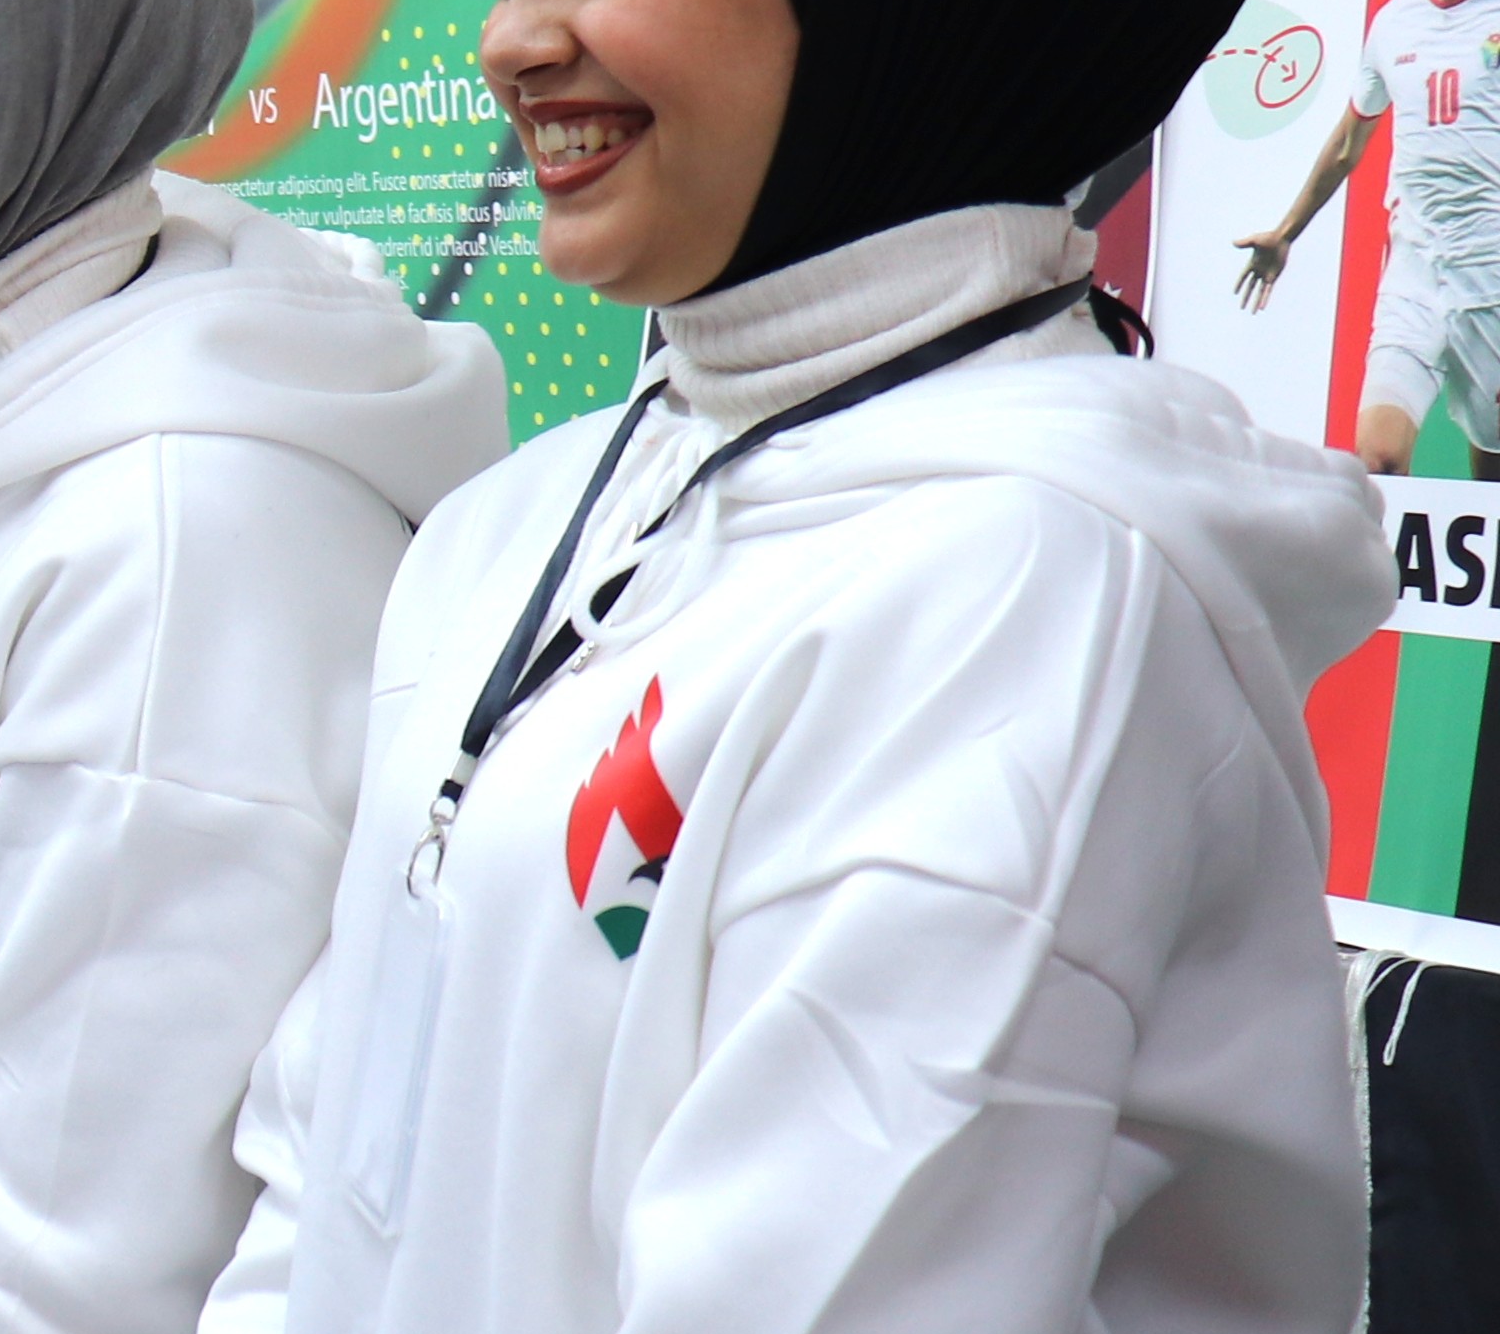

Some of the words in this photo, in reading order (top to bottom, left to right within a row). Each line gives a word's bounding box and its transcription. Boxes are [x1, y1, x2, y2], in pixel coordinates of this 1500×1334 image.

[312, 64, 498, 144] Argentina
[1425, 68, 1460, 127] 10
[277, 173, 344, 199] adipiscing
[346, 170, 371, 192] elit.
[372, 170, 407, 192] Fusce
[409, 170, 485, 191] consectetur
[322, 205, 384, 230] vulputate
[492, 199, 542, 228] pulvina
[488, 233, 541, 257] Vestibu
